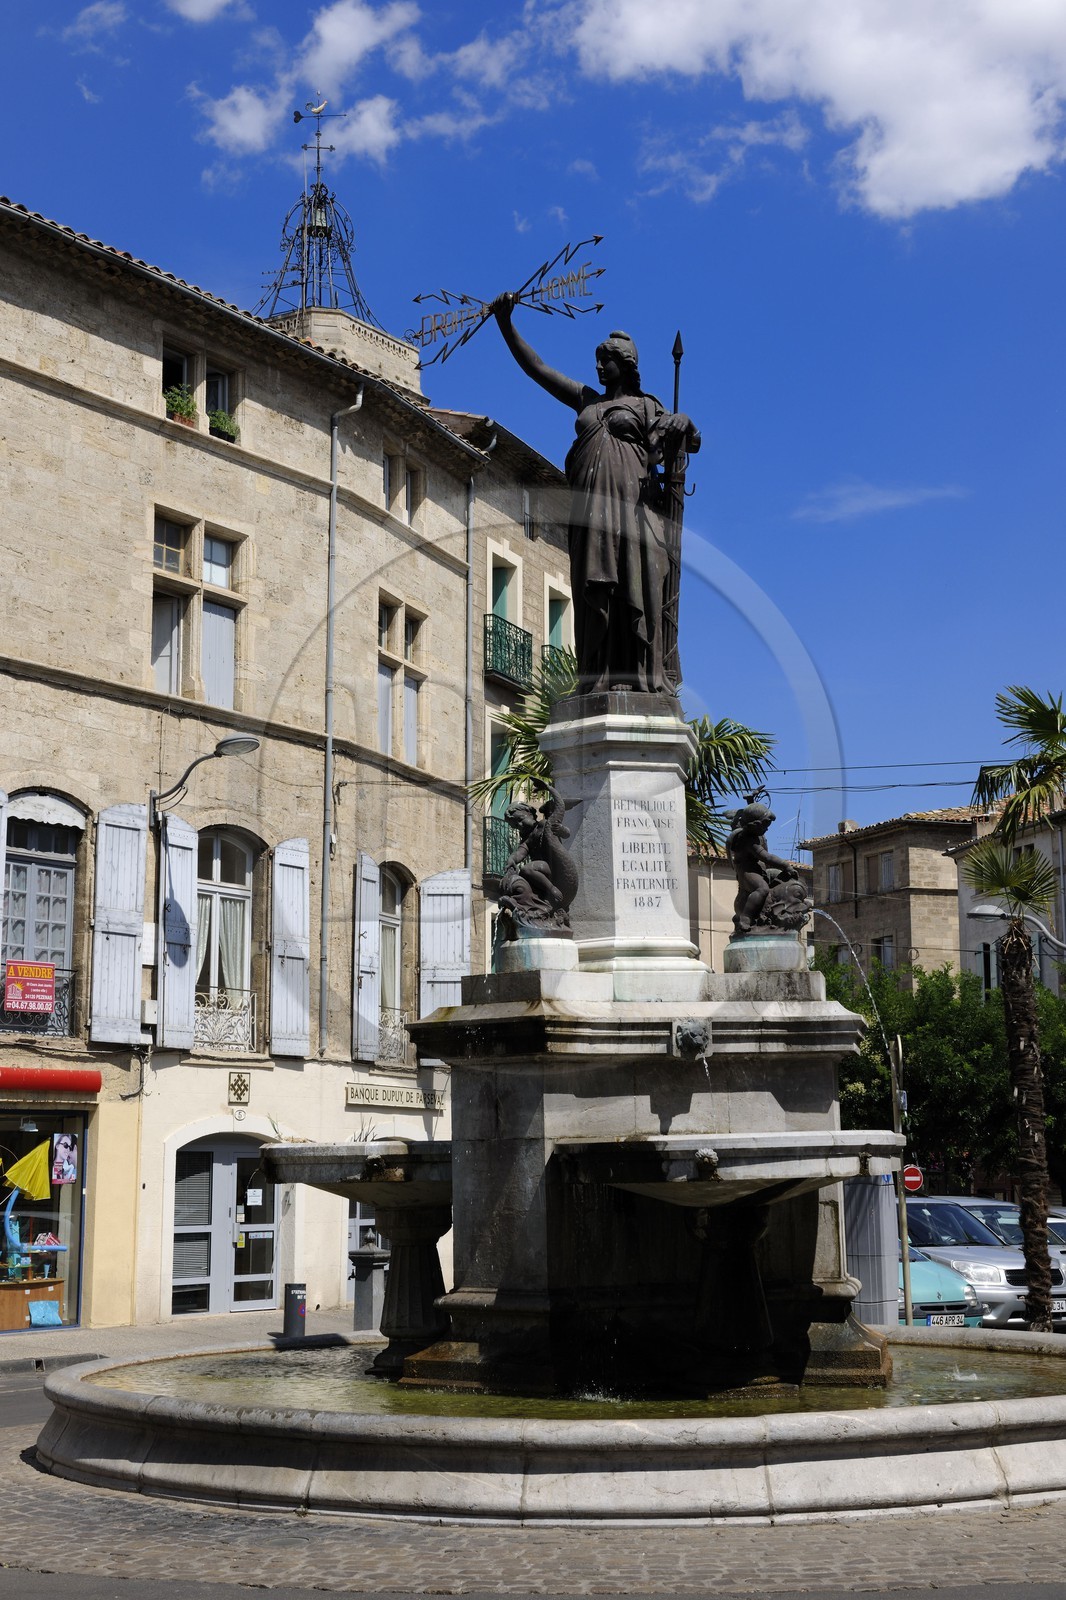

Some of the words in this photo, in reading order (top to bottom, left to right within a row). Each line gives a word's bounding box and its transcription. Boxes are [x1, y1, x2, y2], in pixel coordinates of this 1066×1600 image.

[421, 306, 477, 348] DROITS
[616, 817, 674, 829] FRANÇAISE
[634, 896, 662, 907] 1887
[8, 965, 15, 976] A
[17, 966, 53, 978] VENDRE
[350, 1087, 379, 1103] BANQUE
[406, 1091, 413, 1103] DE
[931, 1316, 944, 1325] 446
[956, 1315, 963, 1325] 34
